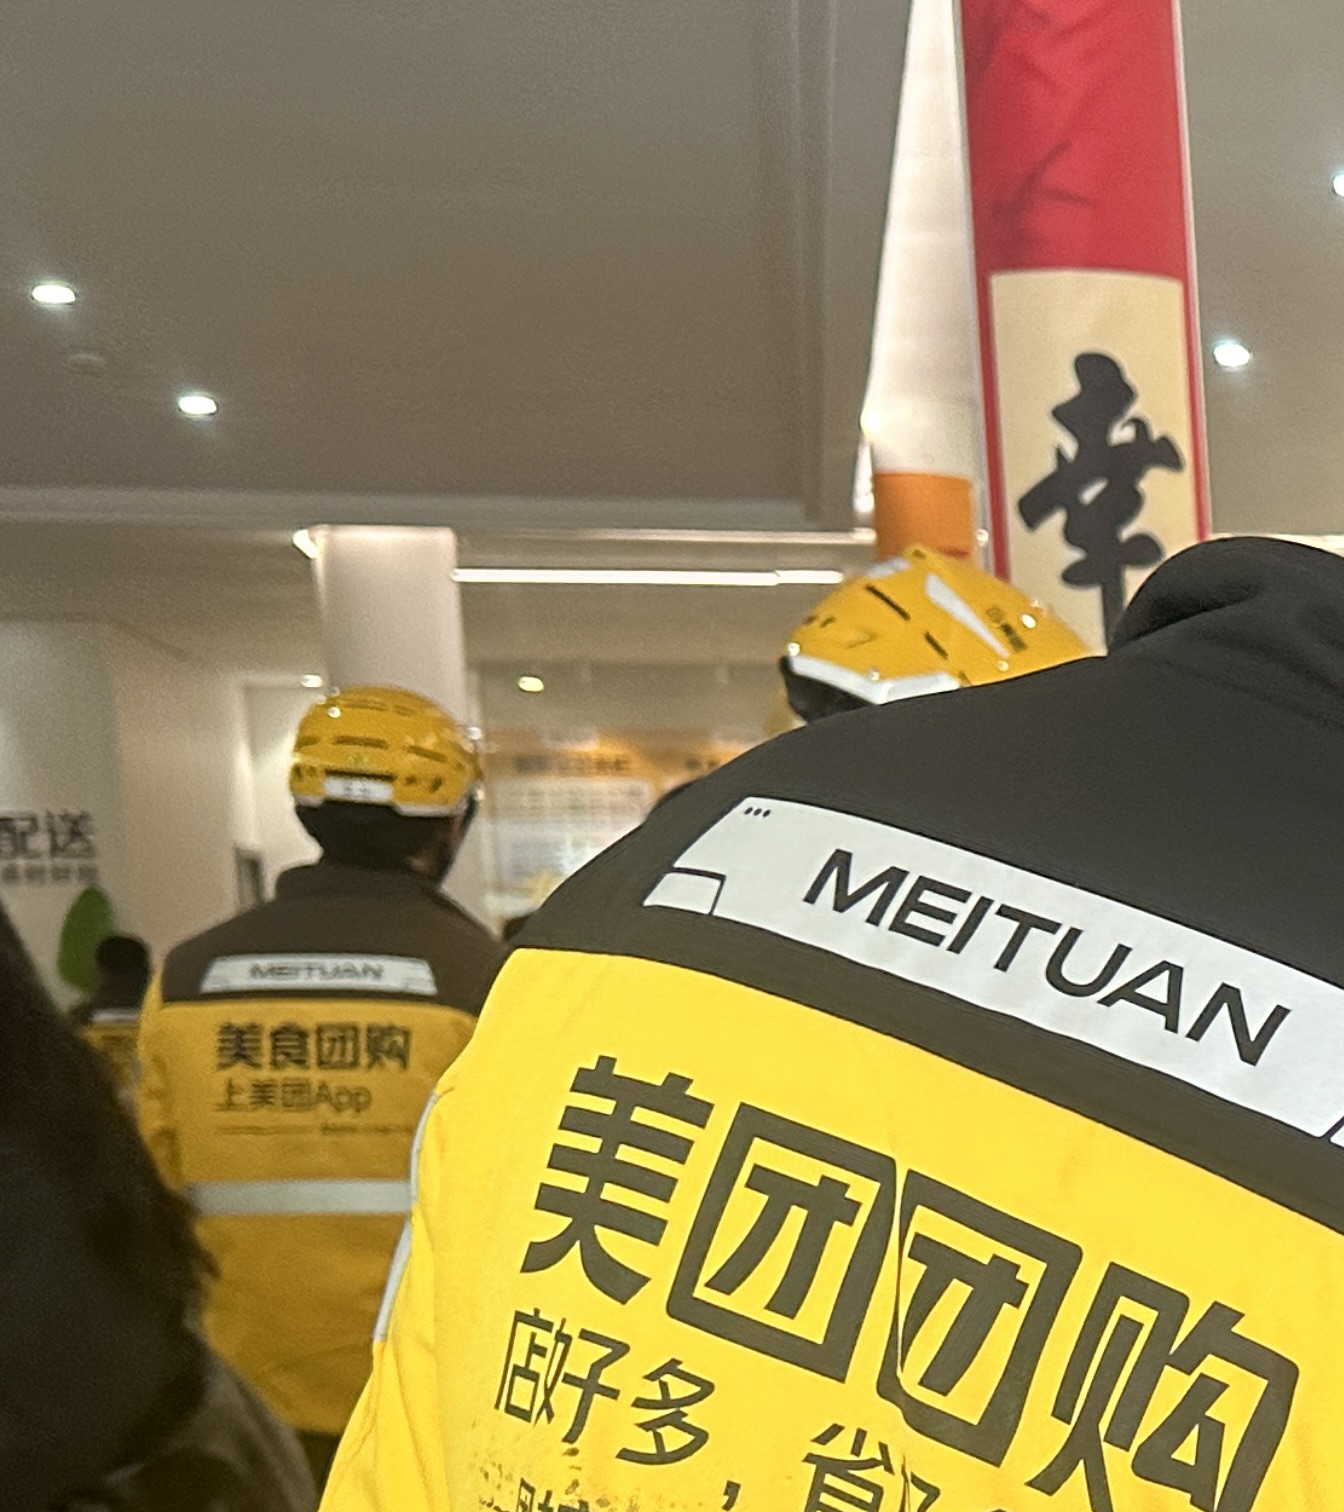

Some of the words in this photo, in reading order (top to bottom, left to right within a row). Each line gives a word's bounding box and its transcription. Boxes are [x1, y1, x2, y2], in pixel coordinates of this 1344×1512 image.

[249, 963, 384, 980] MEITUAN
[803, 848, 1290, 1066] MEITUAN
[215, 1021, 412, 1071] 美食团购
[214, 1077, 372, 1113] 上美团App
